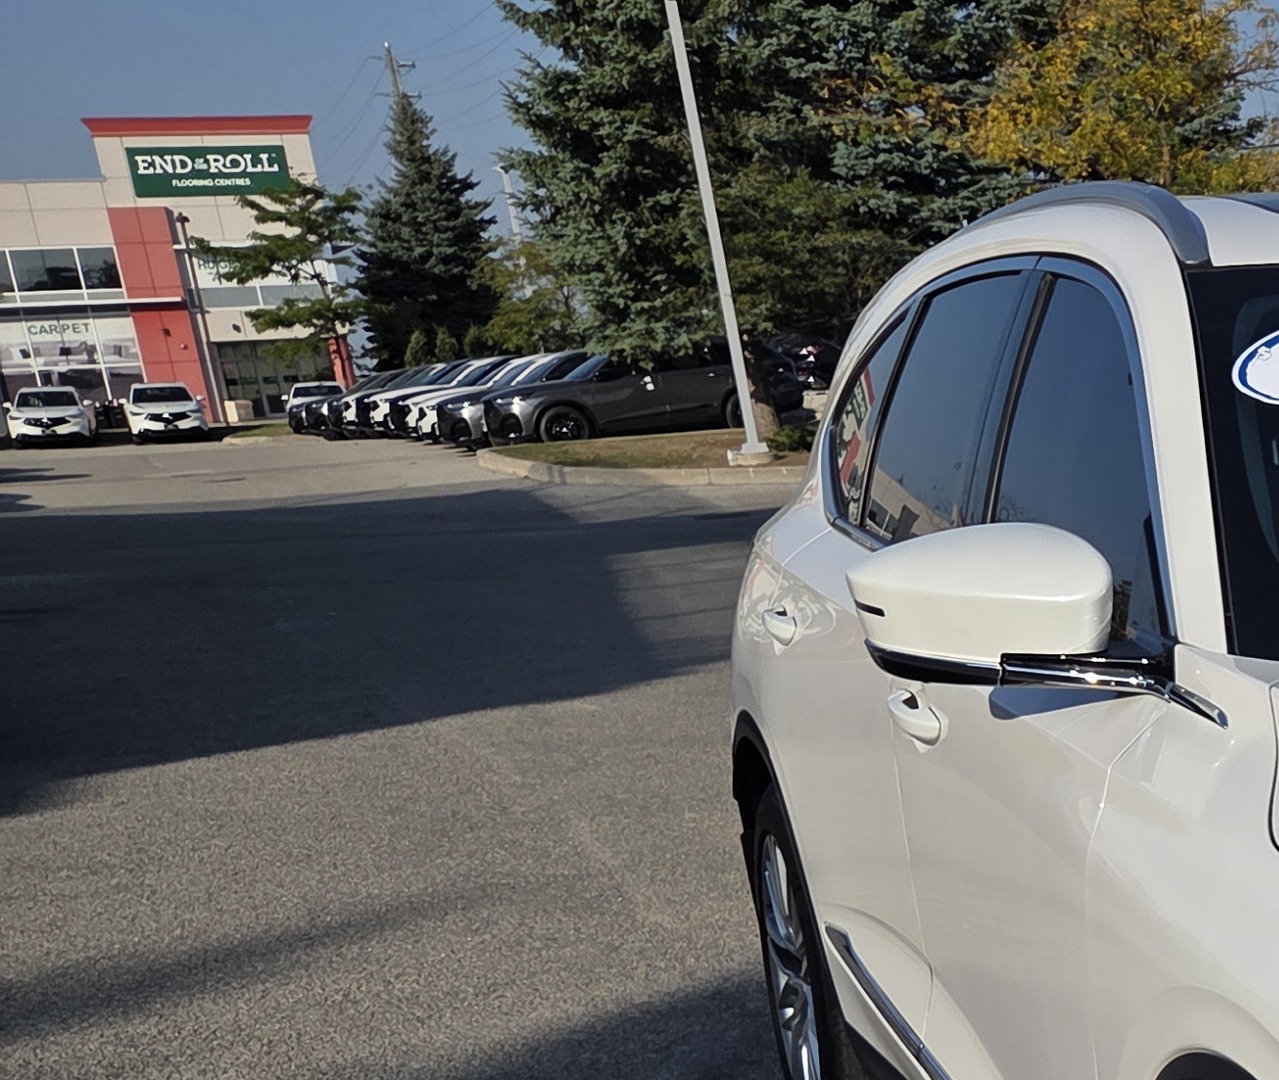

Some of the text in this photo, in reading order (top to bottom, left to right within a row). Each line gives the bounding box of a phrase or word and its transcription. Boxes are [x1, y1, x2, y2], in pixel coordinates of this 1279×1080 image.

[134, 154, 193, 175] END
[206, 153, 279, 173] ROLL
[172, 177, 251, 187] FLOORING CENTRES
[27, 322, 91, 335] CARPET
